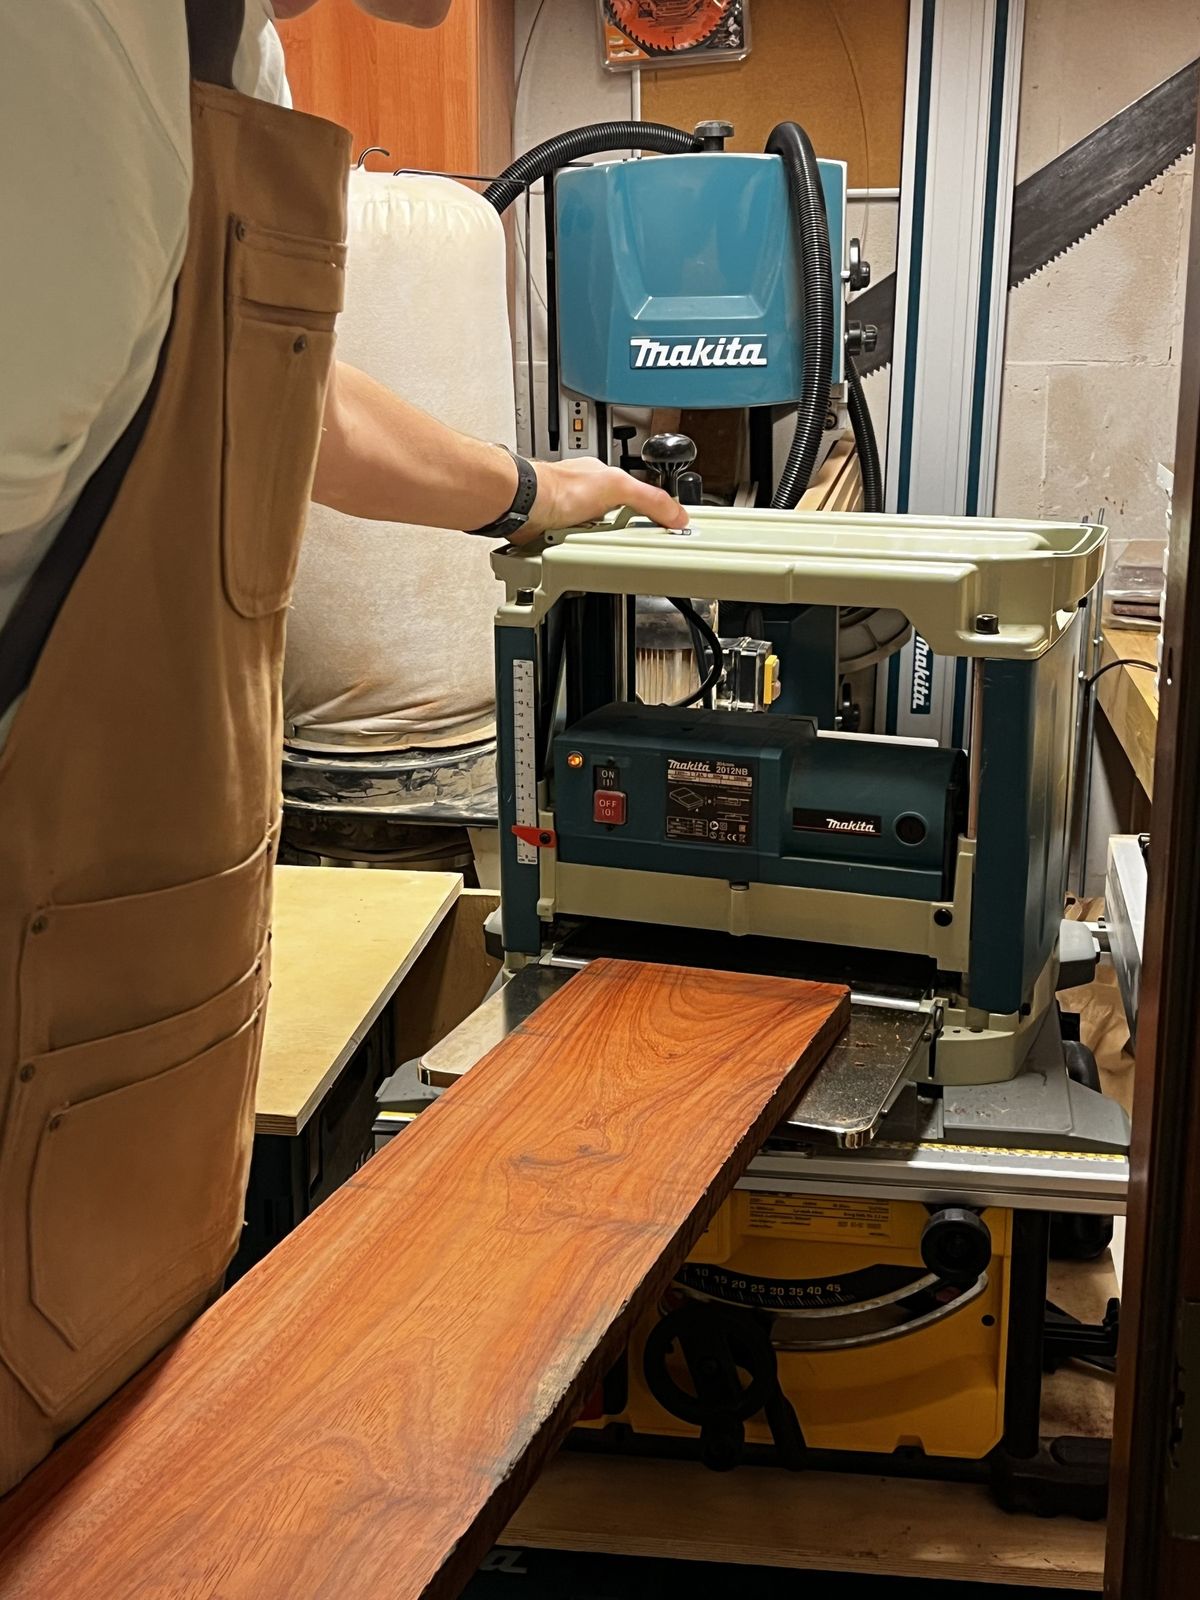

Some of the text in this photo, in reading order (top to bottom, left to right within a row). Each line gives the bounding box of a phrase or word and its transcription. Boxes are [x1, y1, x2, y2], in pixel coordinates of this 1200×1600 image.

[630, 338, 767, 367] Makita
[912, 635, 930, 709] Makita
[601, 770, 615, 778] ON
[668, 760, 711, 772] Makita
[716, 767, 748, 775] 2012NB
[599, 799, 617, 807] OFF
[826, 819, 875, 832] Makita
[695, 1268, 841, 1296] 10 15 20 25 30 35 40 45
